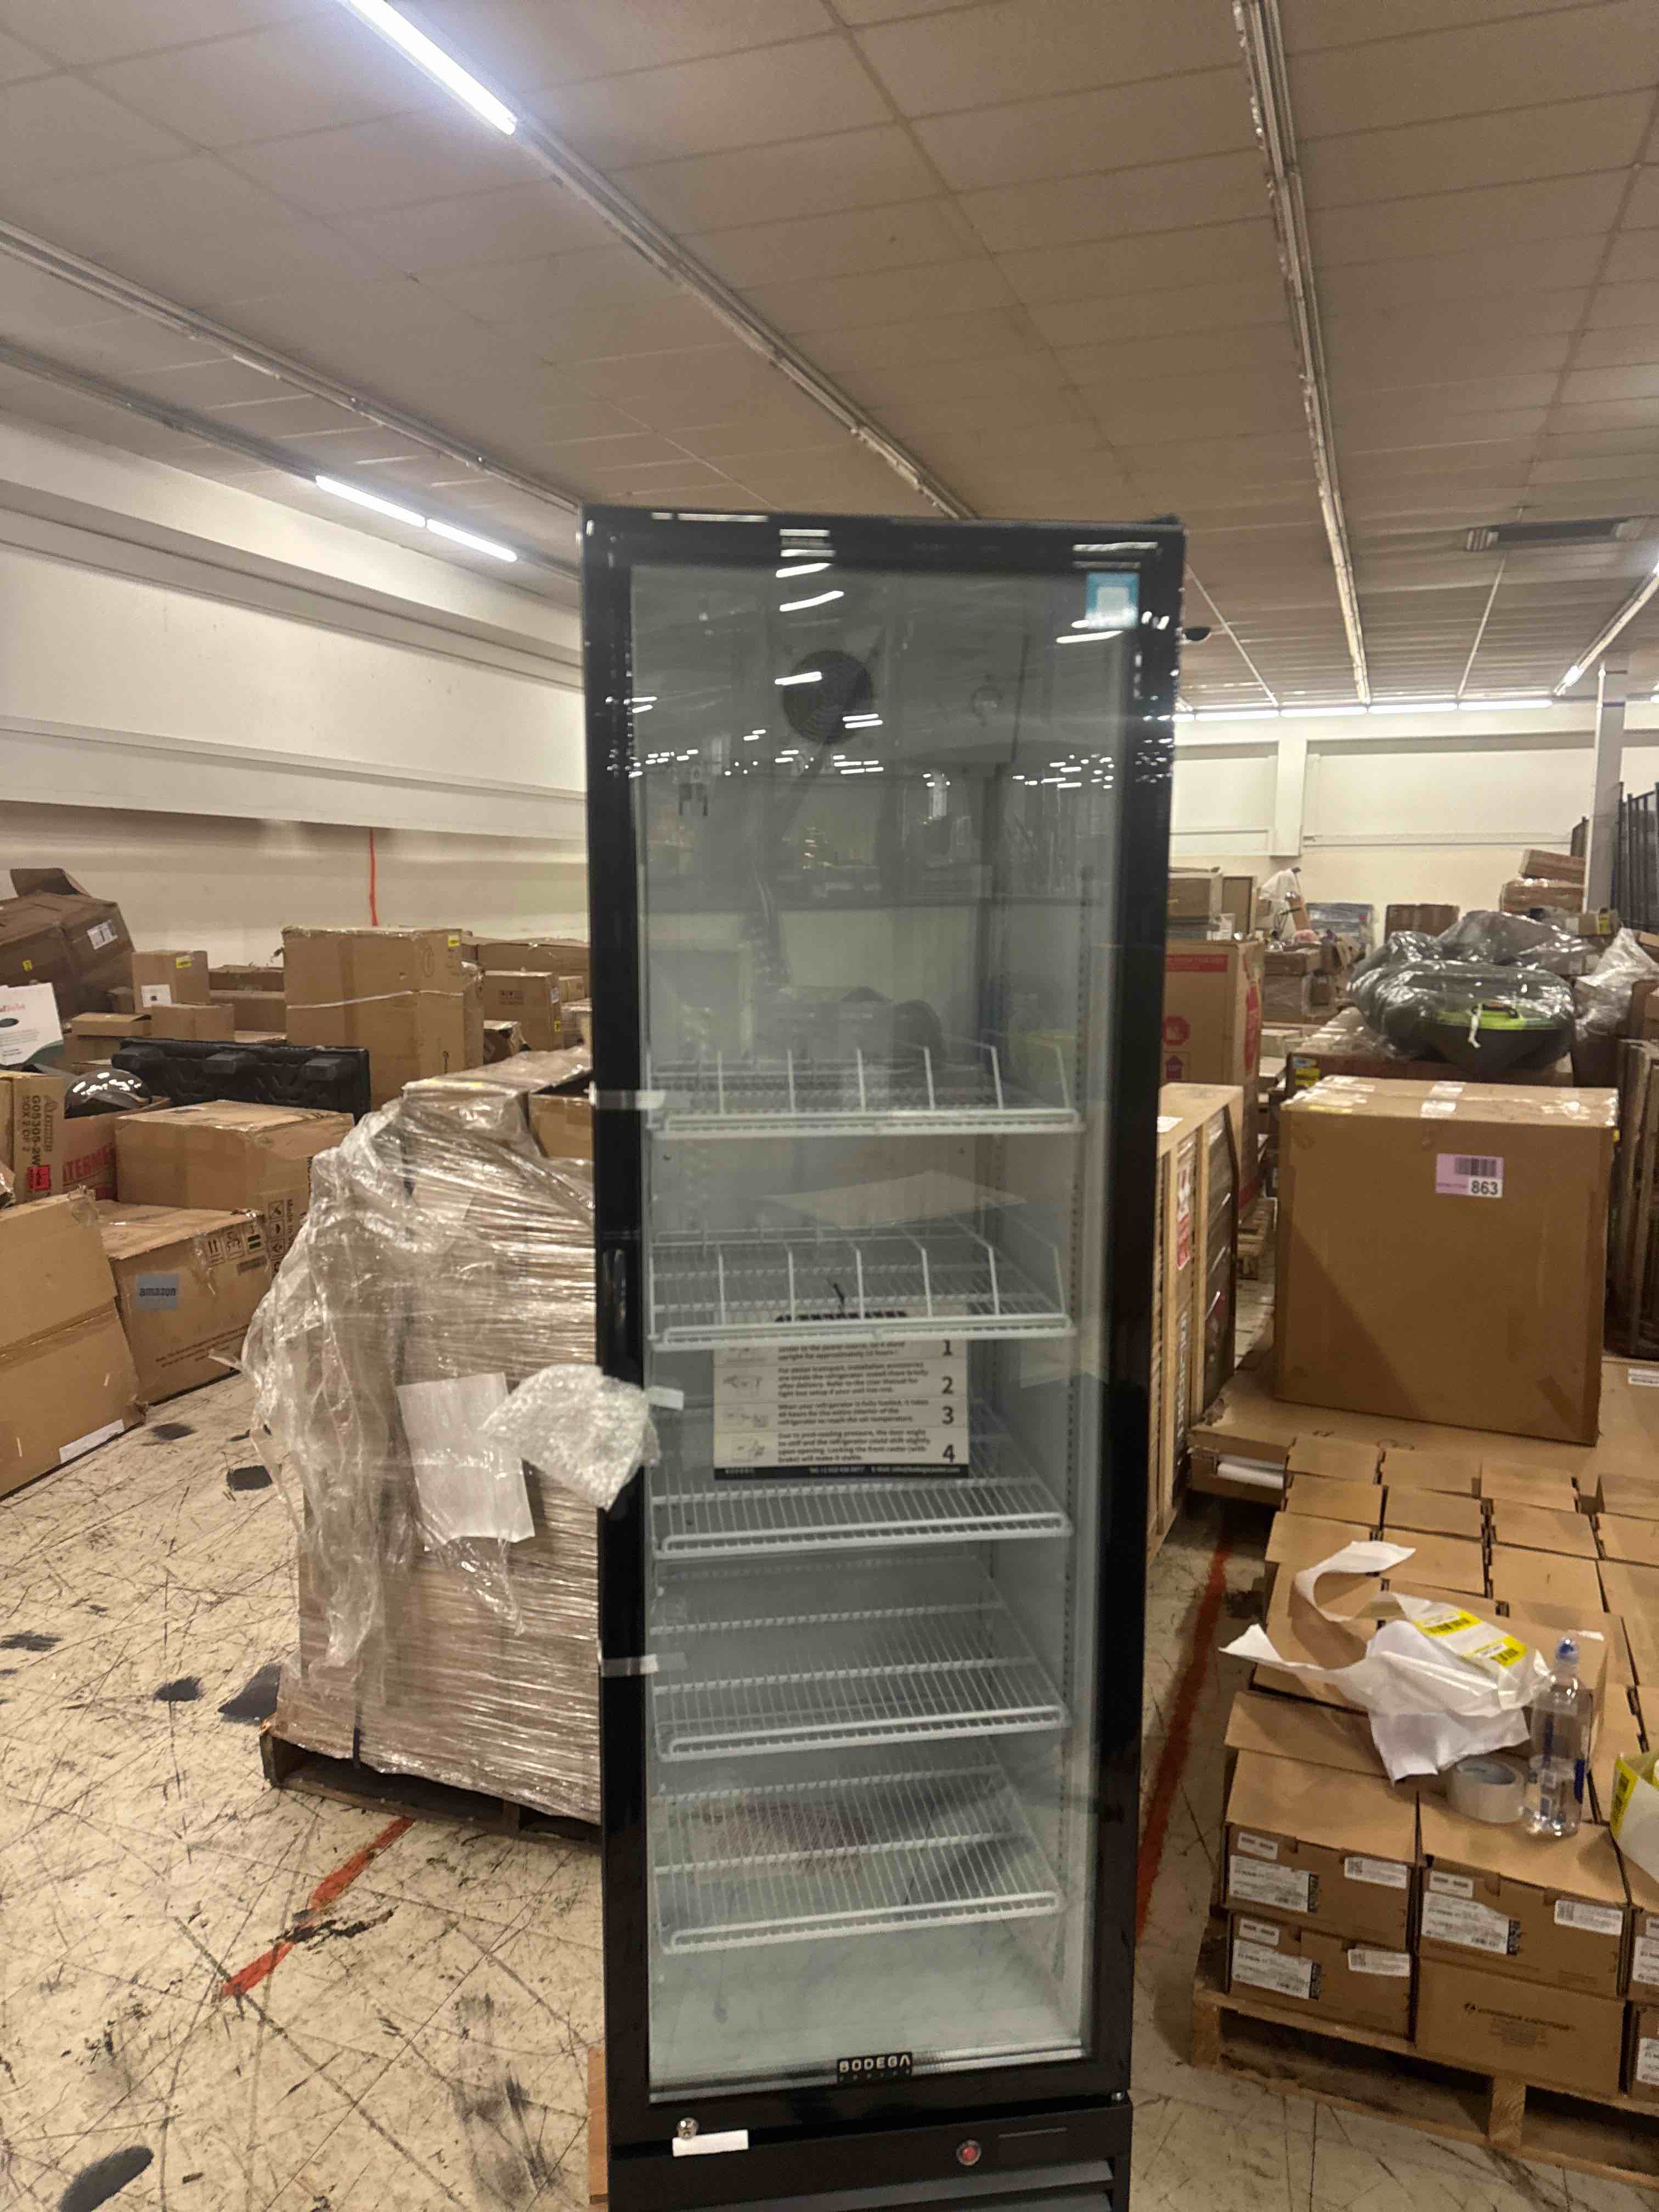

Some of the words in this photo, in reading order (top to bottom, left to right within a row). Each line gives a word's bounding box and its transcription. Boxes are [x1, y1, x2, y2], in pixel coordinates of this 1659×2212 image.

[1471, 1180, 1498, 1195] 863
[139, 1288, 176, 1297] amazon
[943, 1339, 953, 1356] 1
[942, 1375, 953, 1395] 2
[942, 1406, 954, 1425] 3
[942, 1444, 955, 1463] 4
[839, 2053, 911, 2073] BODEGA
